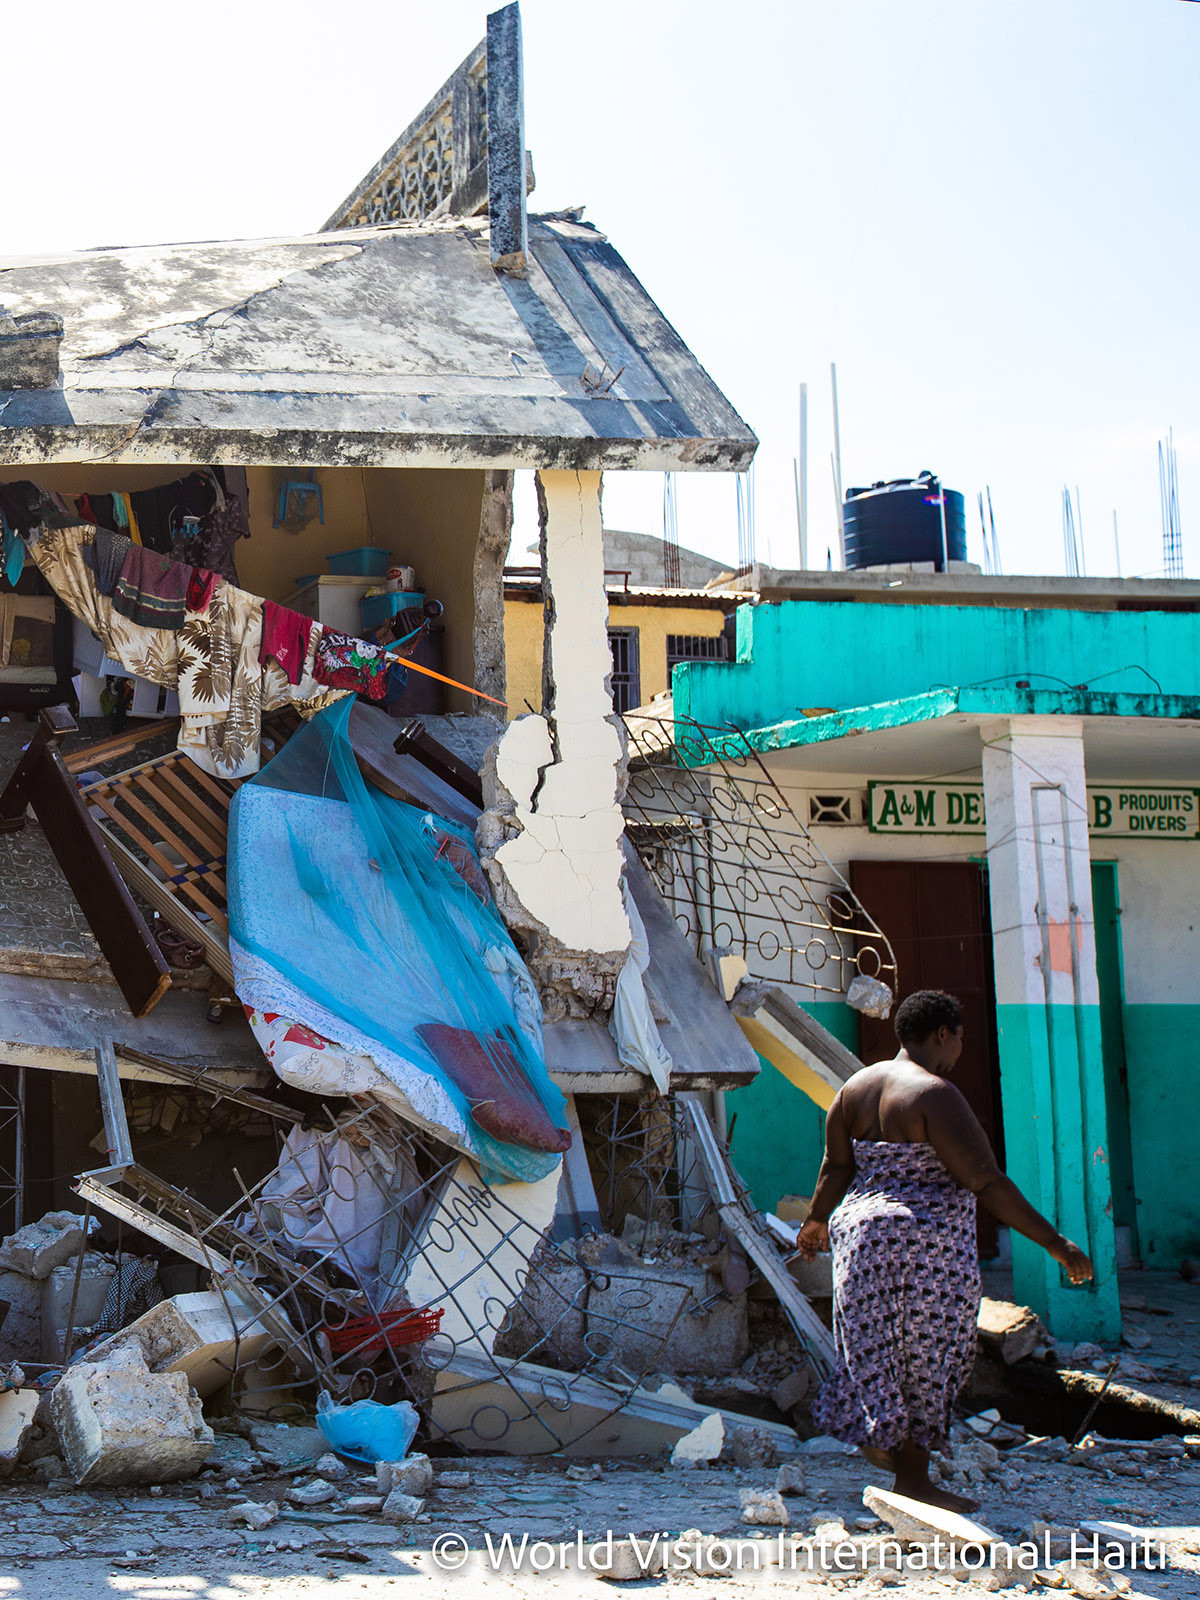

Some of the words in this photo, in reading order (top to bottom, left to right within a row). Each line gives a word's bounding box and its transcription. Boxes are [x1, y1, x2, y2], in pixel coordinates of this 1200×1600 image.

[877, 789, 936, 827] A&M
[945, 792, 987, 826] DE
[1087, 794, 1113, 829] B
[1119, 793, 1194, 812] PRODUITS
[1128, 814, 1187, 832] DIVERS
